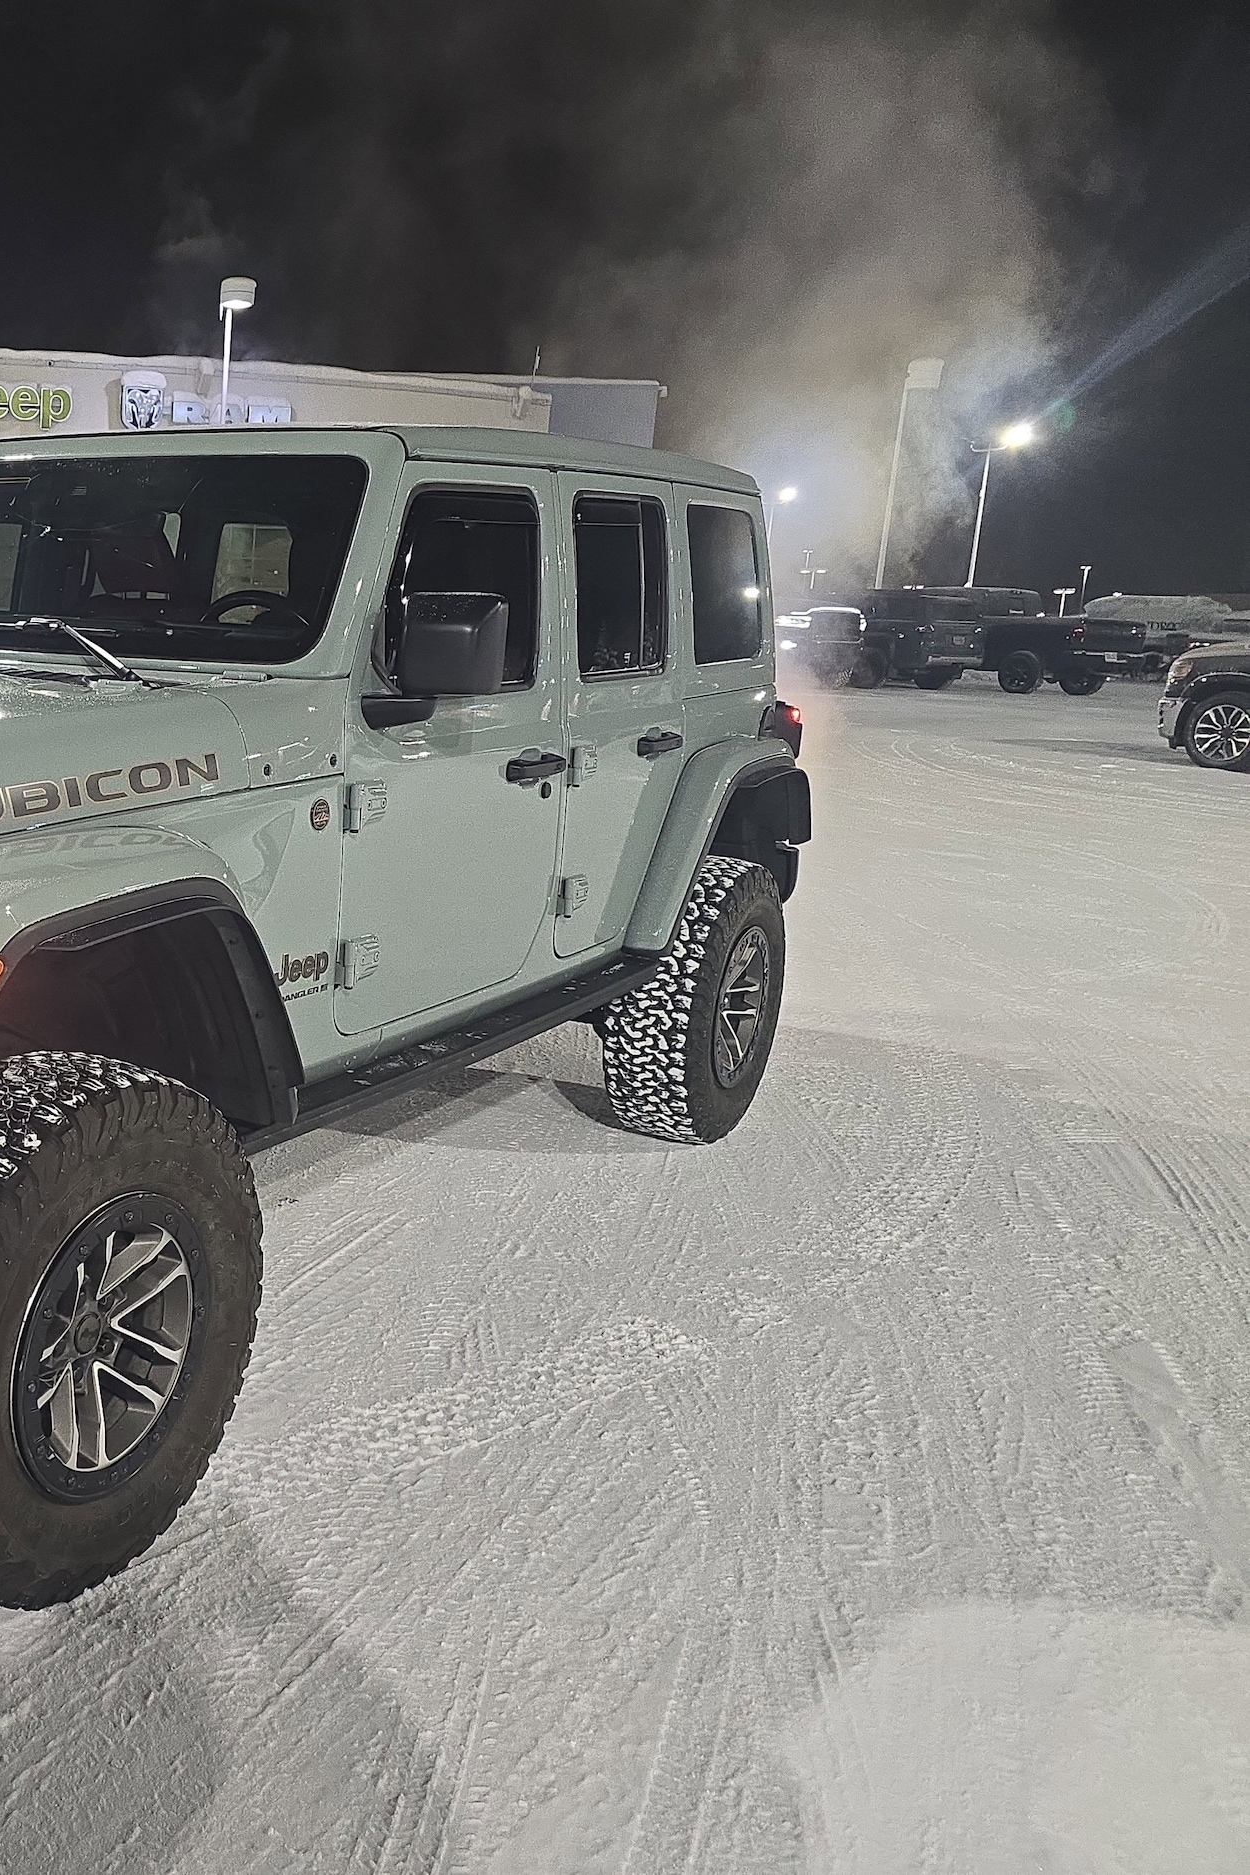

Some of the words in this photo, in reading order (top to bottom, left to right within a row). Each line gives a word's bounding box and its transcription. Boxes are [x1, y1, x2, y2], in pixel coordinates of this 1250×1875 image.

[171, 400, 292, 425] RAM
[274, 950, 329, 987] Jeep
[281, 986, 319, 1002] ANGLER
